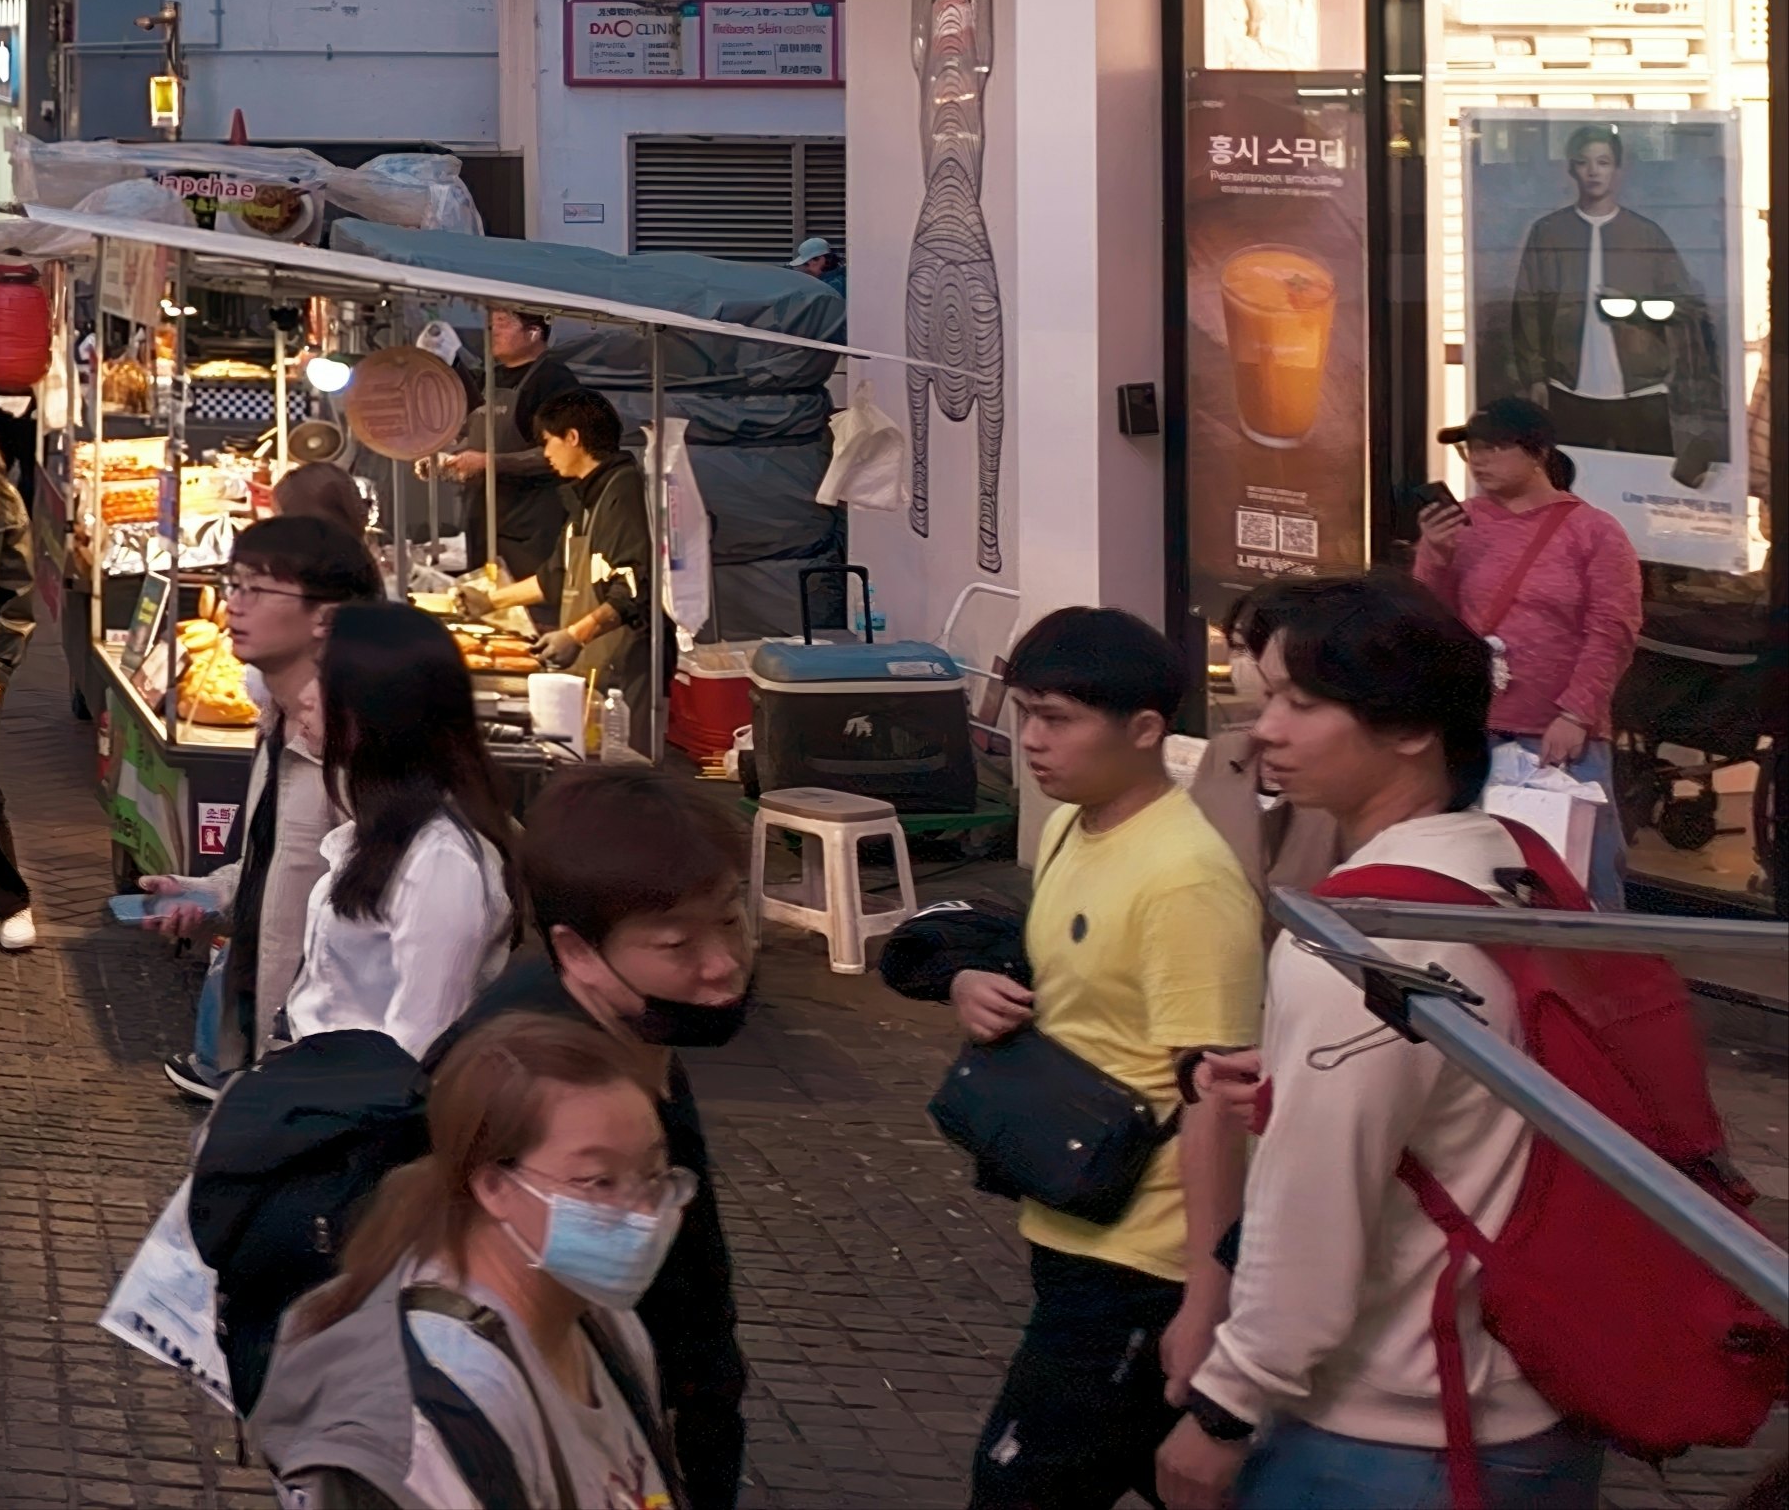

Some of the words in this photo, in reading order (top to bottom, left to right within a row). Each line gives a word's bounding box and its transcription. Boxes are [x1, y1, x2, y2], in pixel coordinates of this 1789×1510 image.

[588, 19, 634, 38] DAO
[1207, 134, 1259, 166] 홍시
[1266, 138, 1347, 170] 스무디
